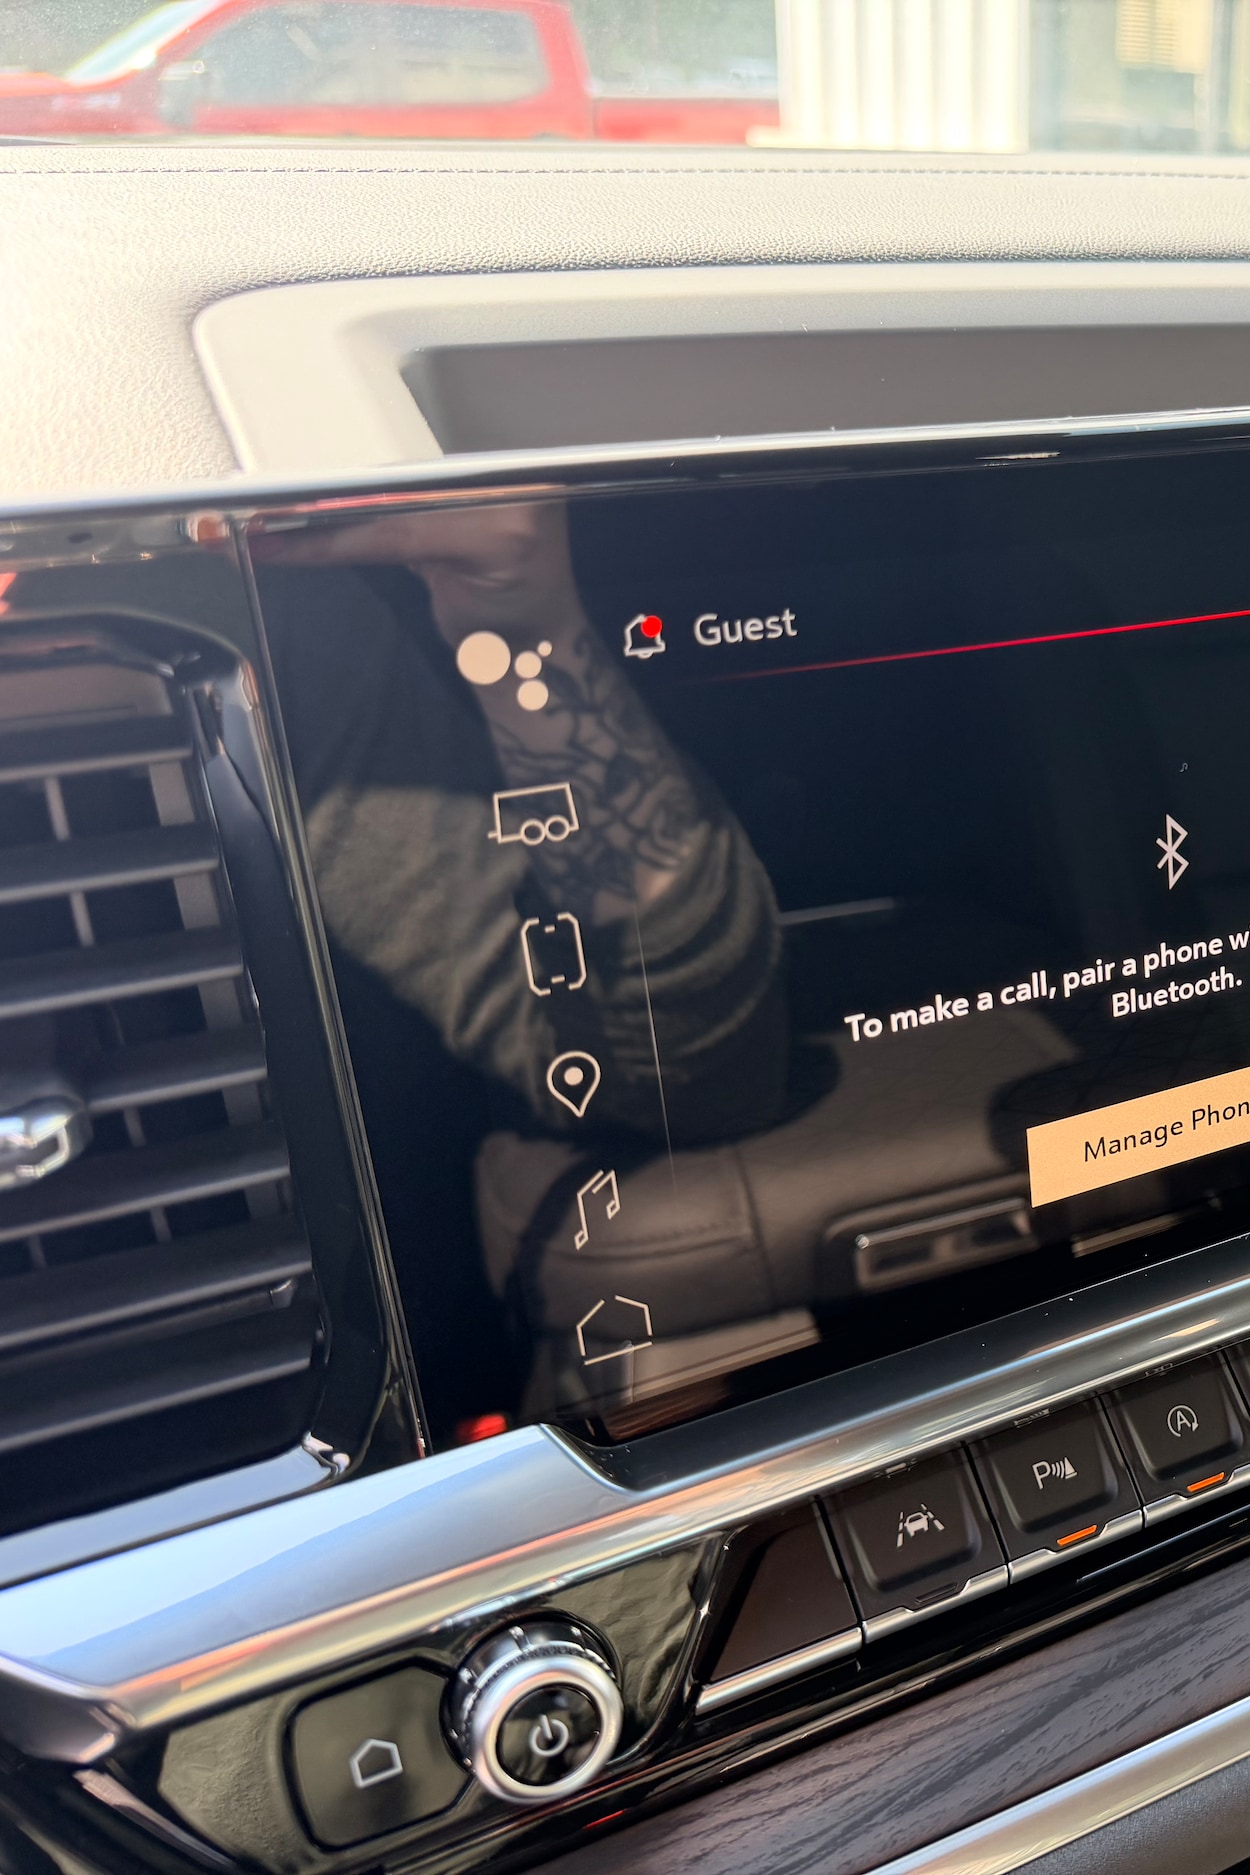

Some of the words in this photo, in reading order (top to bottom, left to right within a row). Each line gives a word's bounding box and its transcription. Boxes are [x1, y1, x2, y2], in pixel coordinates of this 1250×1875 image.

[693, 608, 798, 646] Guest
[843, 1012, 883, 1042] To
[890, 993, 970, 1033] make
[977, 991, 994, 1012] a
[1000, 970, 1057, 1006] call,
[1063, 958, 1116, 997] pair
[1121, 957, 1137, 977] a
[1142, 937, 1224, 978] phone
[1110, 966, 1243, 1018] Bluetooth.
[1084, 1120, 1184, 1162] Manage
